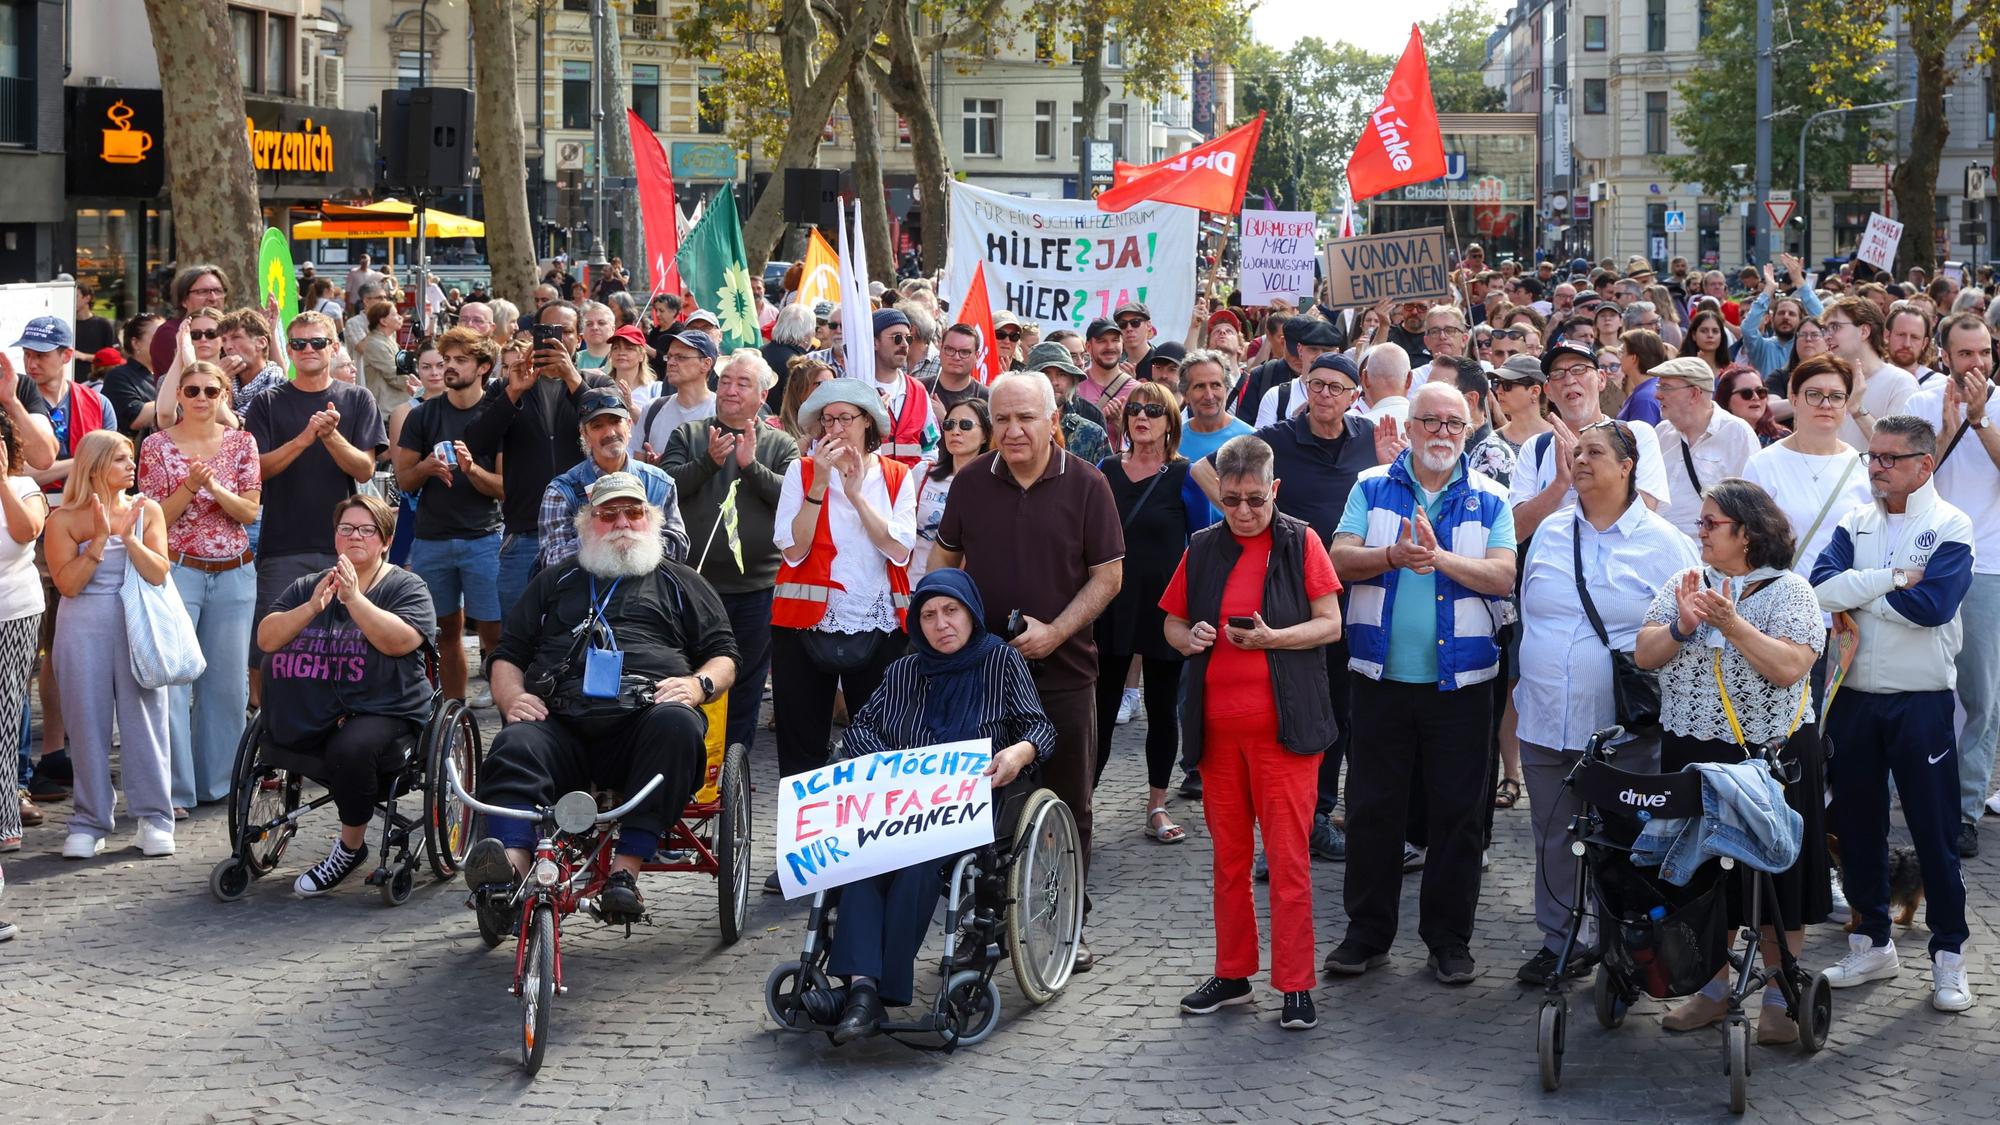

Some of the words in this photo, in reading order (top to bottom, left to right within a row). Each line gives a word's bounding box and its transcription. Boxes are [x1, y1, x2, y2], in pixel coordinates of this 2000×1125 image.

[246, 116, 334, 172] erzenich
[974, 201, 1005, 223] FÜR
[1262, 237, 1298, 254] MACH
[1341, 238, 1433, 271] VONOVIA
[1243, 256, 1315, 271] WOHNUNGSAMT
[1262, 272, 1300, 292] VOLL!
[1350, 263, 1445, 300] ENTEIGNEN
[1909, 554, 1929, 563] QAT
[271, 652, 366, 682] RIGHTS
[791, 762, 855, 800] ICH
[884, 778, 978, 816] FACH
[1619, 788, 1667, 807] drive
[785, 836, 850, 886] NUR
[857, 801, 990, 849] WOHNEN
